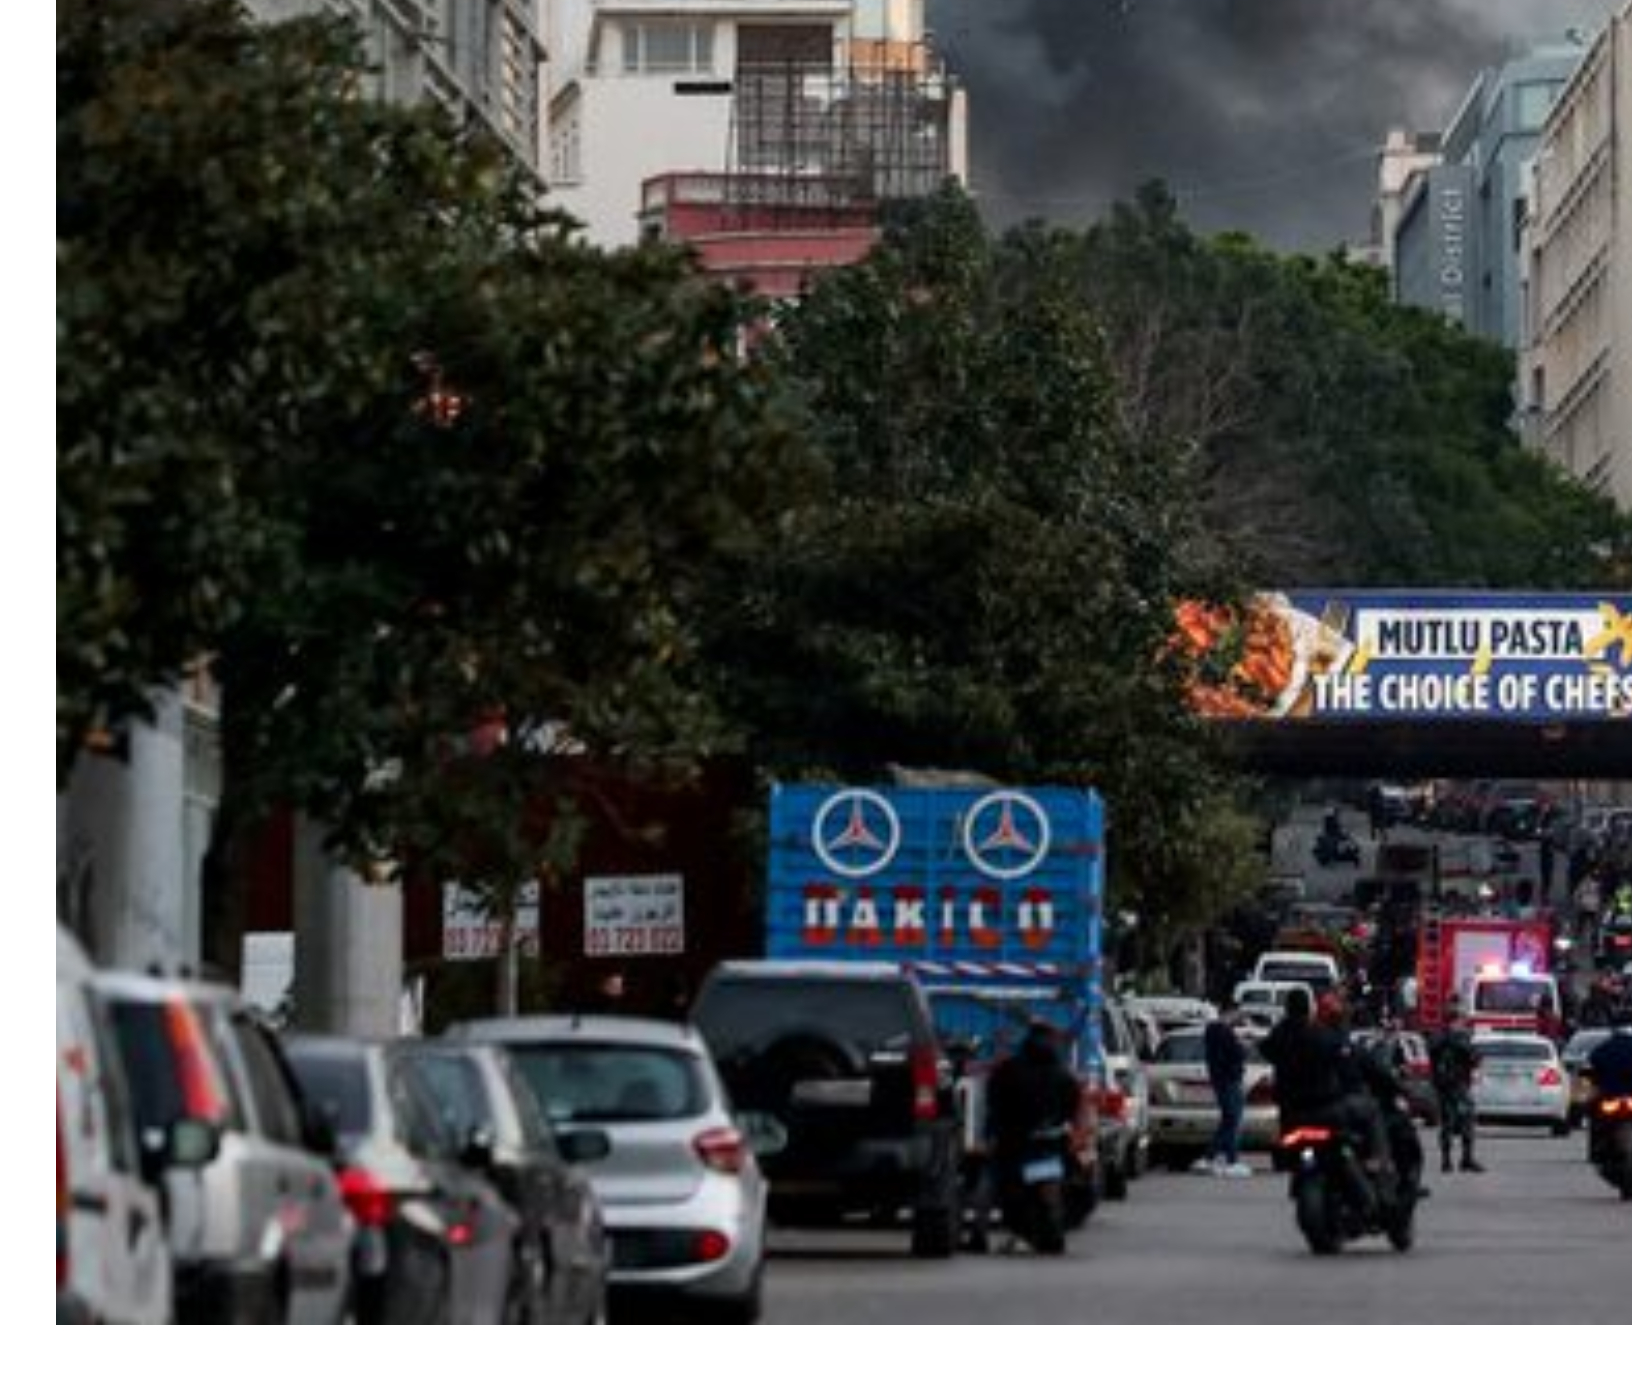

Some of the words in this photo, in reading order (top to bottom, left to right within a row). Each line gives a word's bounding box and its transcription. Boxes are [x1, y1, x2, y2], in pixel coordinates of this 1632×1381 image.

[1378, 619, 1481, 655] MUTLU
[1490, 619, 1584, 655] PASTA
[1313, 674, 1372, 710] THE
[1379, 674, 1490, 710] CHOICE
[1497, 674, 1538, 710] OF
